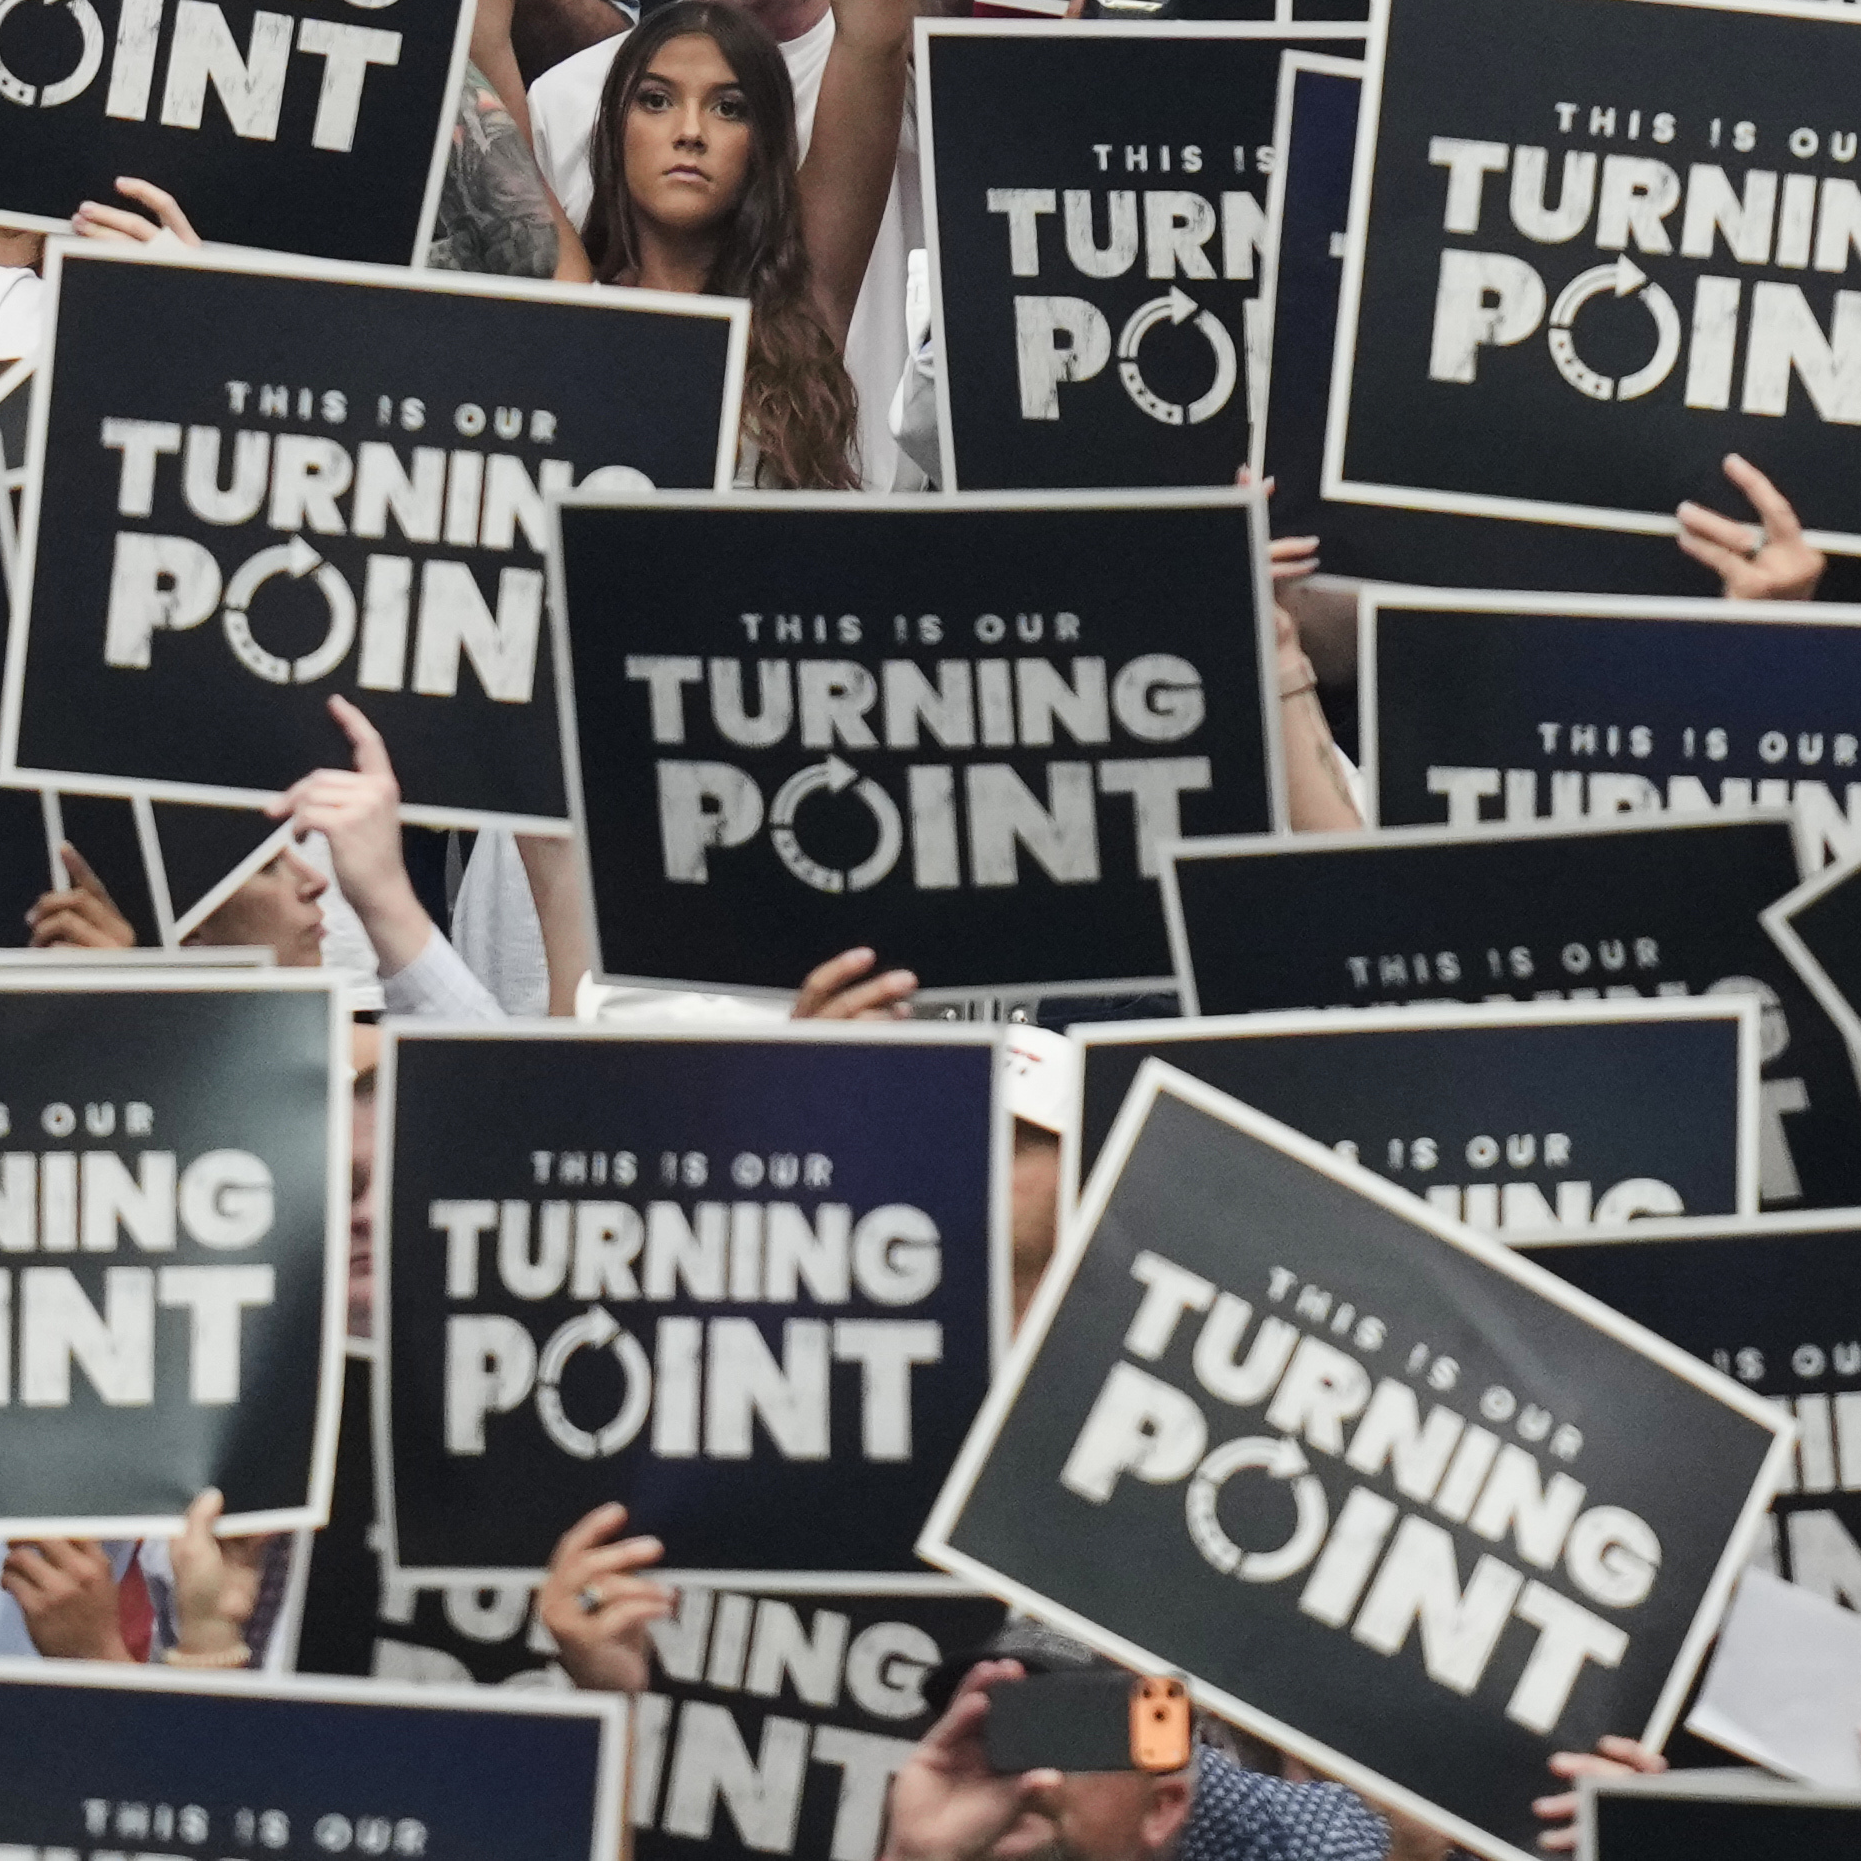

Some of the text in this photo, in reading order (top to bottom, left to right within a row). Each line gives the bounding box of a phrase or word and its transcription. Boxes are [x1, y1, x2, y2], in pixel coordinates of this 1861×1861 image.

[1555, 102, 1675, 143] THIS
[1710, 119, 1755, 152] IS
[741, 612, 1080, 644] THIS IS OUR
[626, 654, 1204, 748] TURNING
[657, 755, 1220, 900] POINT
[42, 1102, 153, 1137] OUR
[533, 1151, 833, 1188] THIS IS OUR
[430, 1200, 940, 1304] TURNING
[445, 1307, 942, 1459] POINT
[1269, 1267, 1582, 1458] THIS IS OUR
[1123, 1244, 1669, 1616] TURNING
[1053, 1353, 1638, 1744] POINT
